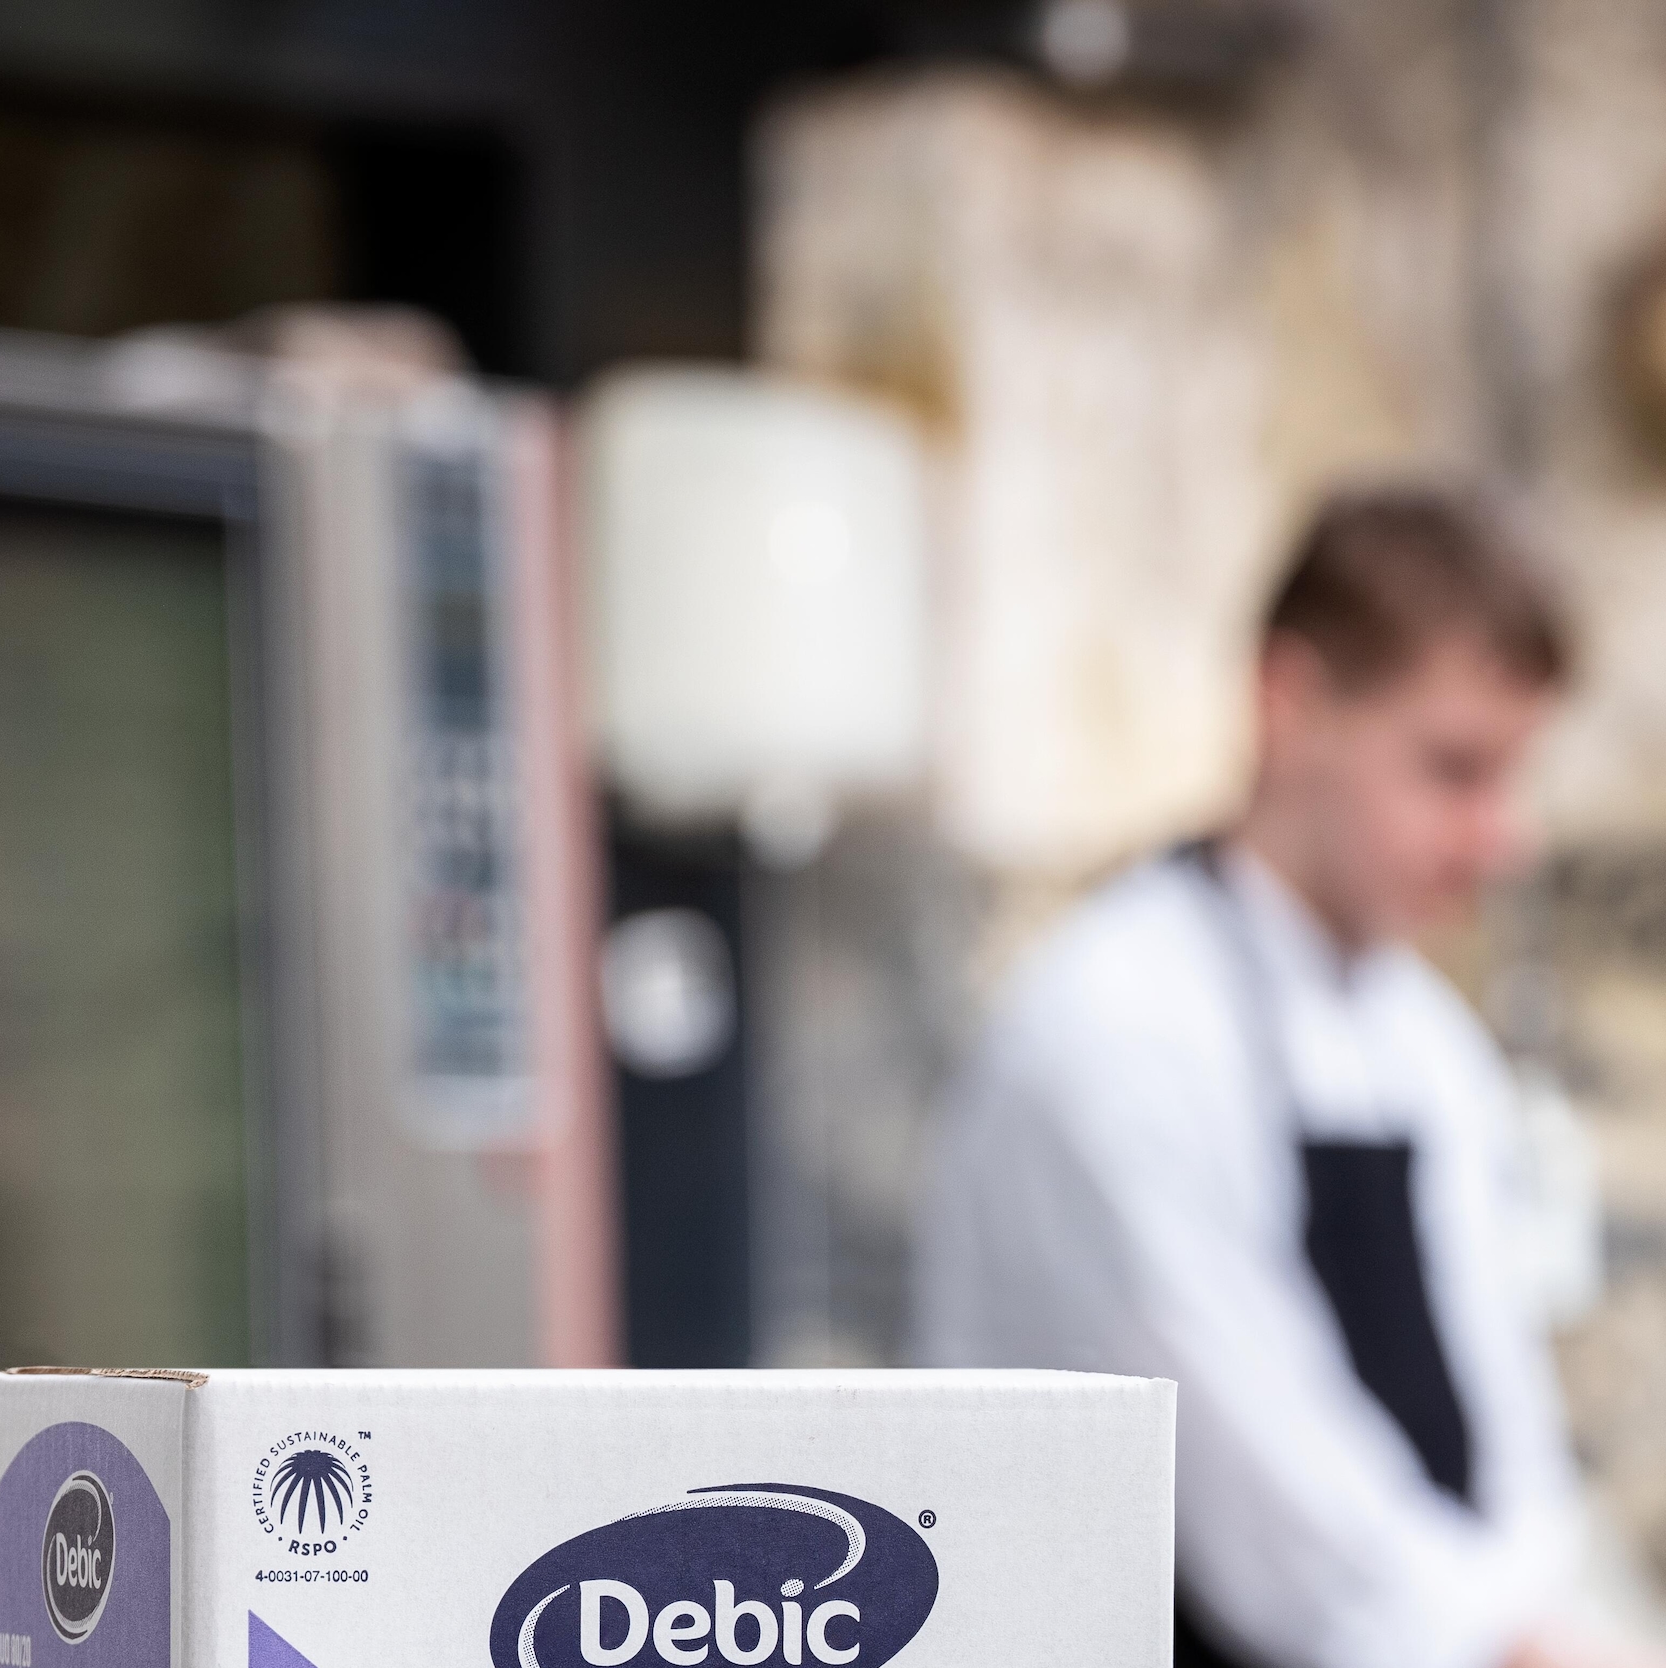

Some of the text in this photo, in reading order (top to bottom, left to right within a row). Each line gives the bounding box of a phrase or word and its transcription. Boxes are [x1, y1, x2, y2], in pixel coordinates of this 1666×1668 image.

[252, 1430, 373, 1534] CERTIFIED SUSTAINABLE PALM OIL
[55, 1532, 102, 1590] Debic
[254, 1569, 370, 1584] 4-0031-07-100-00
[287, 1538, 338, 1557] RSPO
[578, 1577, 861, 1668] Debic
